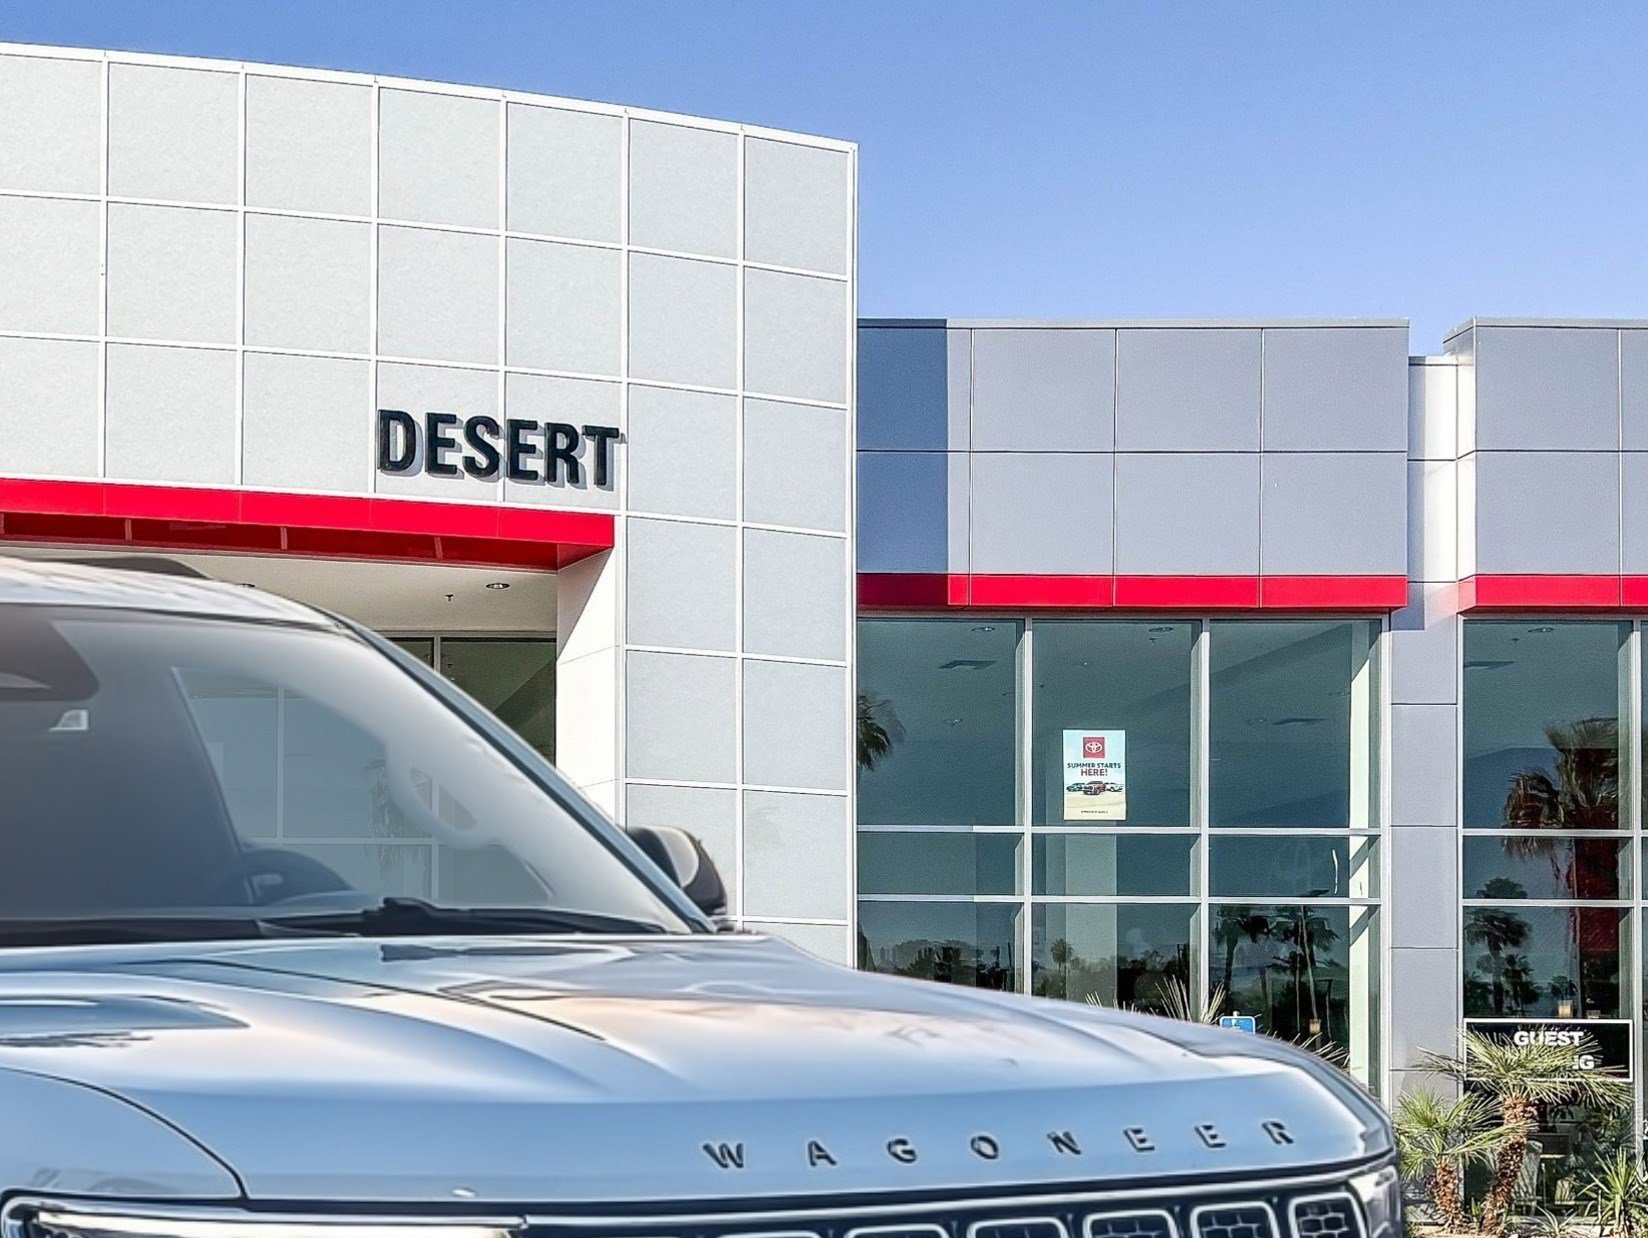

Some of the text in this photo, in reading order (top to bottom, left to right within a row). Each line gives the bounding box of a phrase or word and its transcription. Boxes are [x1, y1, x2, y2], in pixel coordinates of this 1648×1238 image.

[377, 408, 621, 488] DESERT
[1081, 768, 1108, 776] HERE!
[1513, 1031, 1583, 1047] GUEST
[703, 1119, 1293, 1169] WAGONEER
